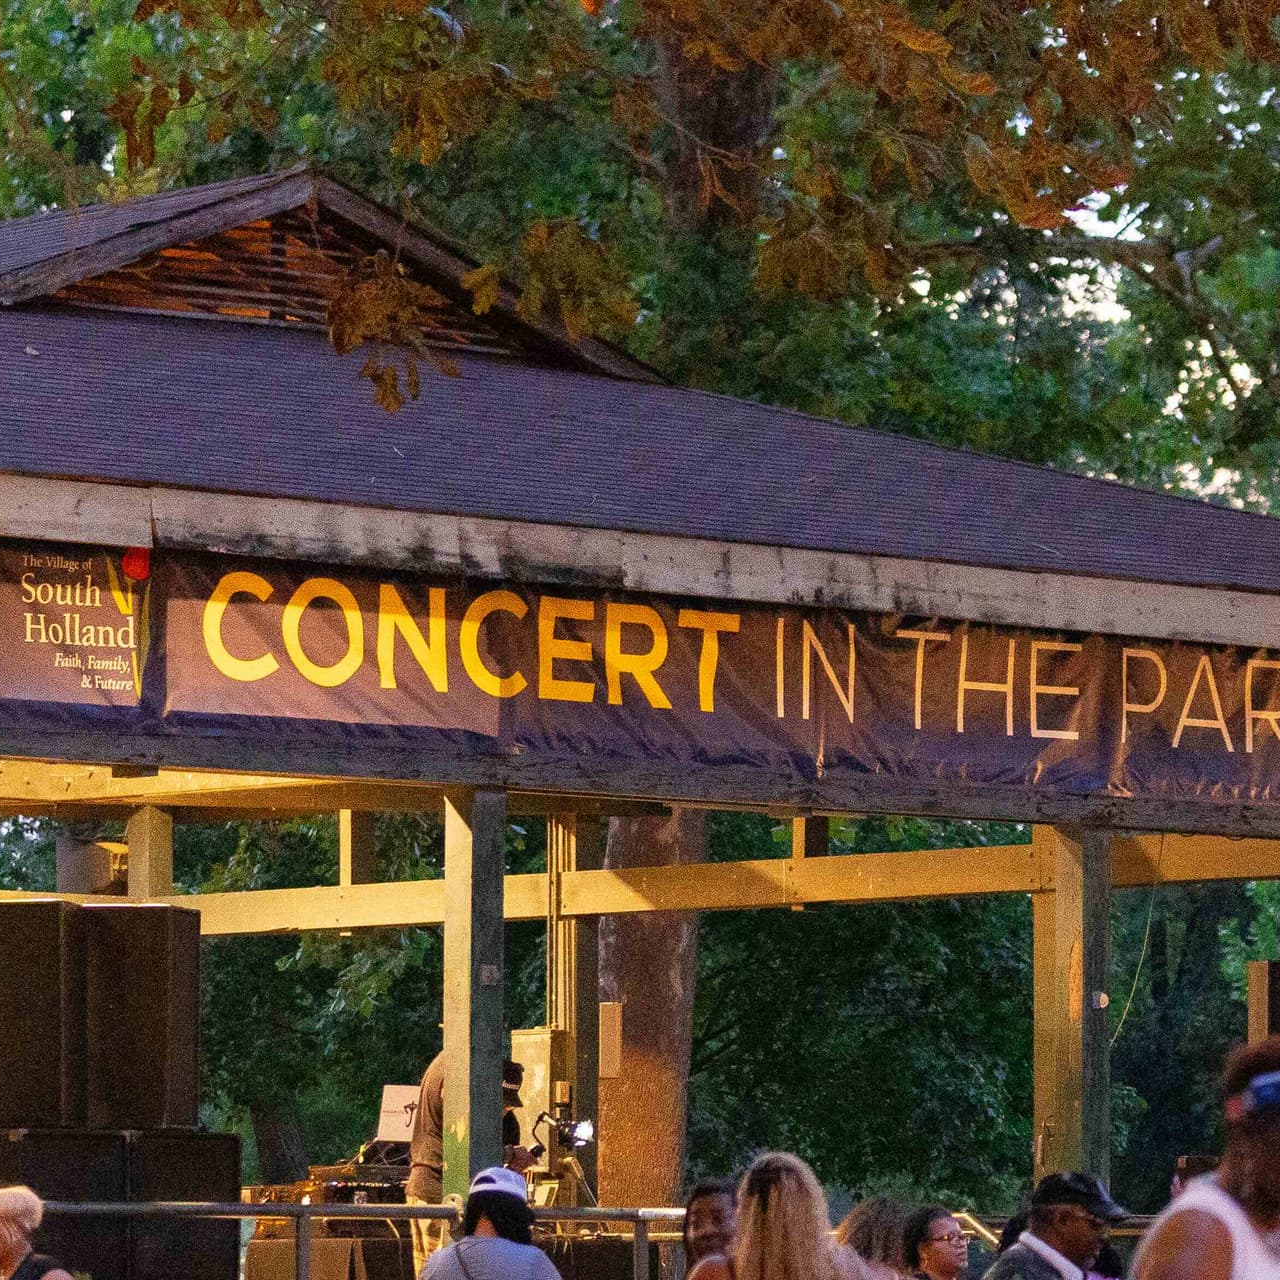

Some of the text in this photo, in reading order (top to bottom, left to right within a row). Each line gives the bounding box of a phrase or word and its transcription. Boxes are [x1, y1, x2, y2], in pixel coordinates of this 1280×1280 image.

[22, 555, 93, 572] The Village of
[21, 572, 102, 607] South
[23, 612, 137, 649] Holland
[54, 652, 131, 674] Faith, Family,
[202, 570, 740, 713] CONCERT
[776, 617, 855, 724] IN
[896, 628, 1082, 741] THE
[81, 674, 134, 691] & Future
